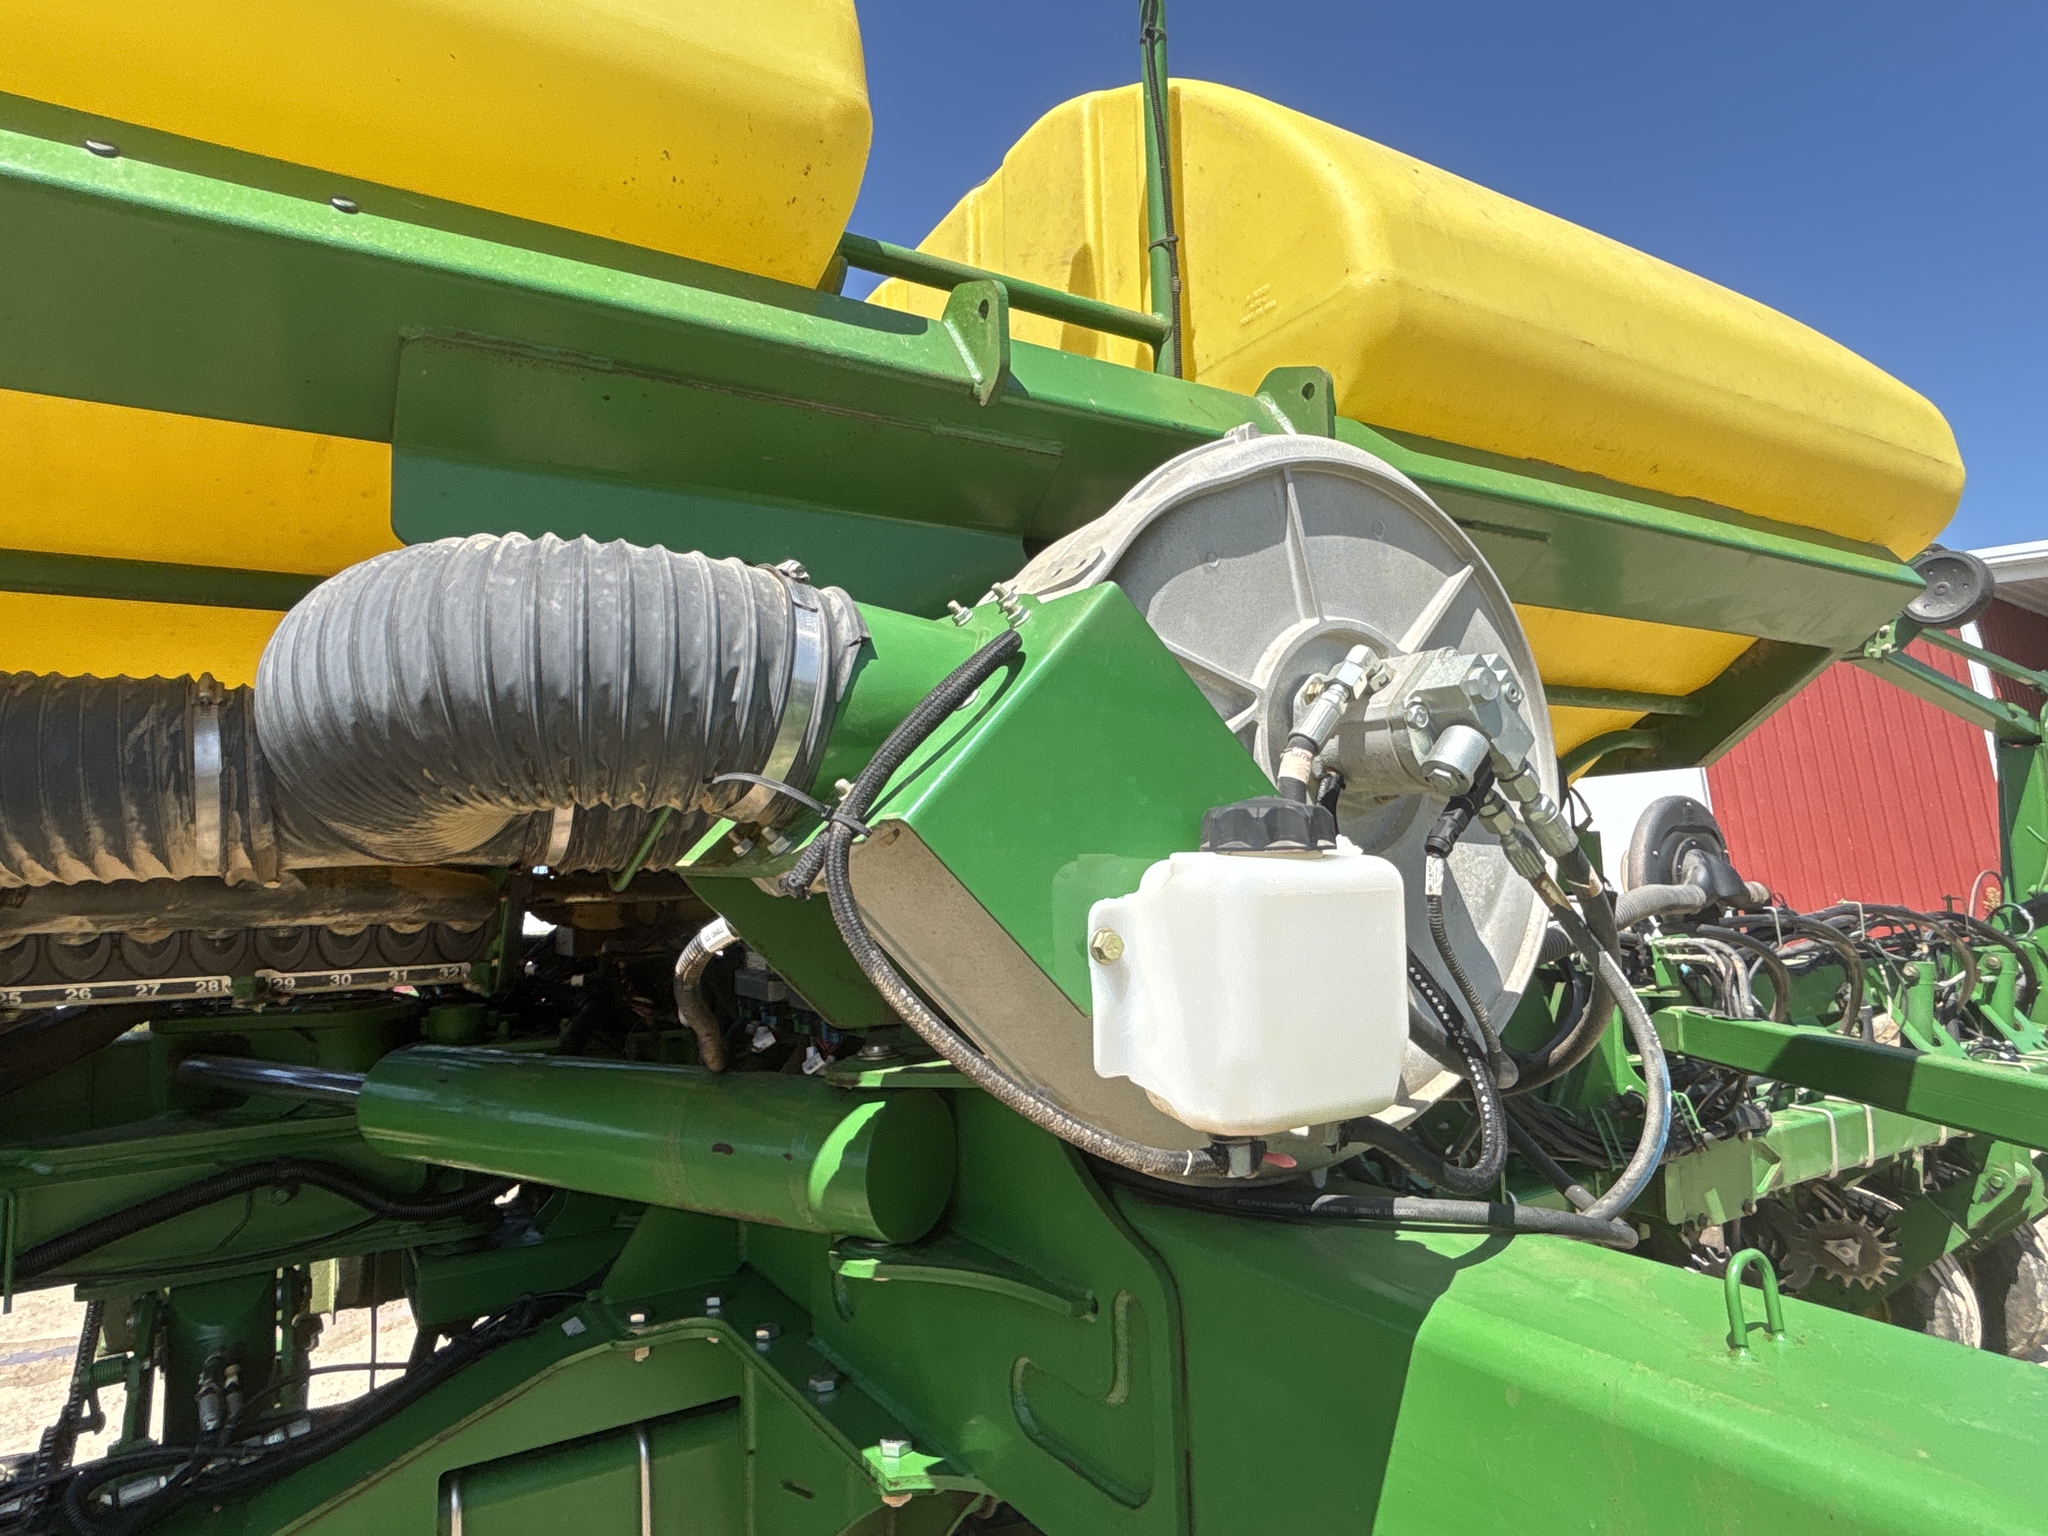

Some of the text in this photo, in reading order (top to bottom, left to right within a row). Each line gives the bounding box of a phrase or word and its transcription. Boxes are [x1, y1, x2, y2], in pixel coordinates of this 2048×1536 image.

[272, 967, 460, 990] 29 30 31 32
[65, 988, 92, 1001] 26
[135, 984, 161, 997] 27
[195, 980, 219, 993] 28
